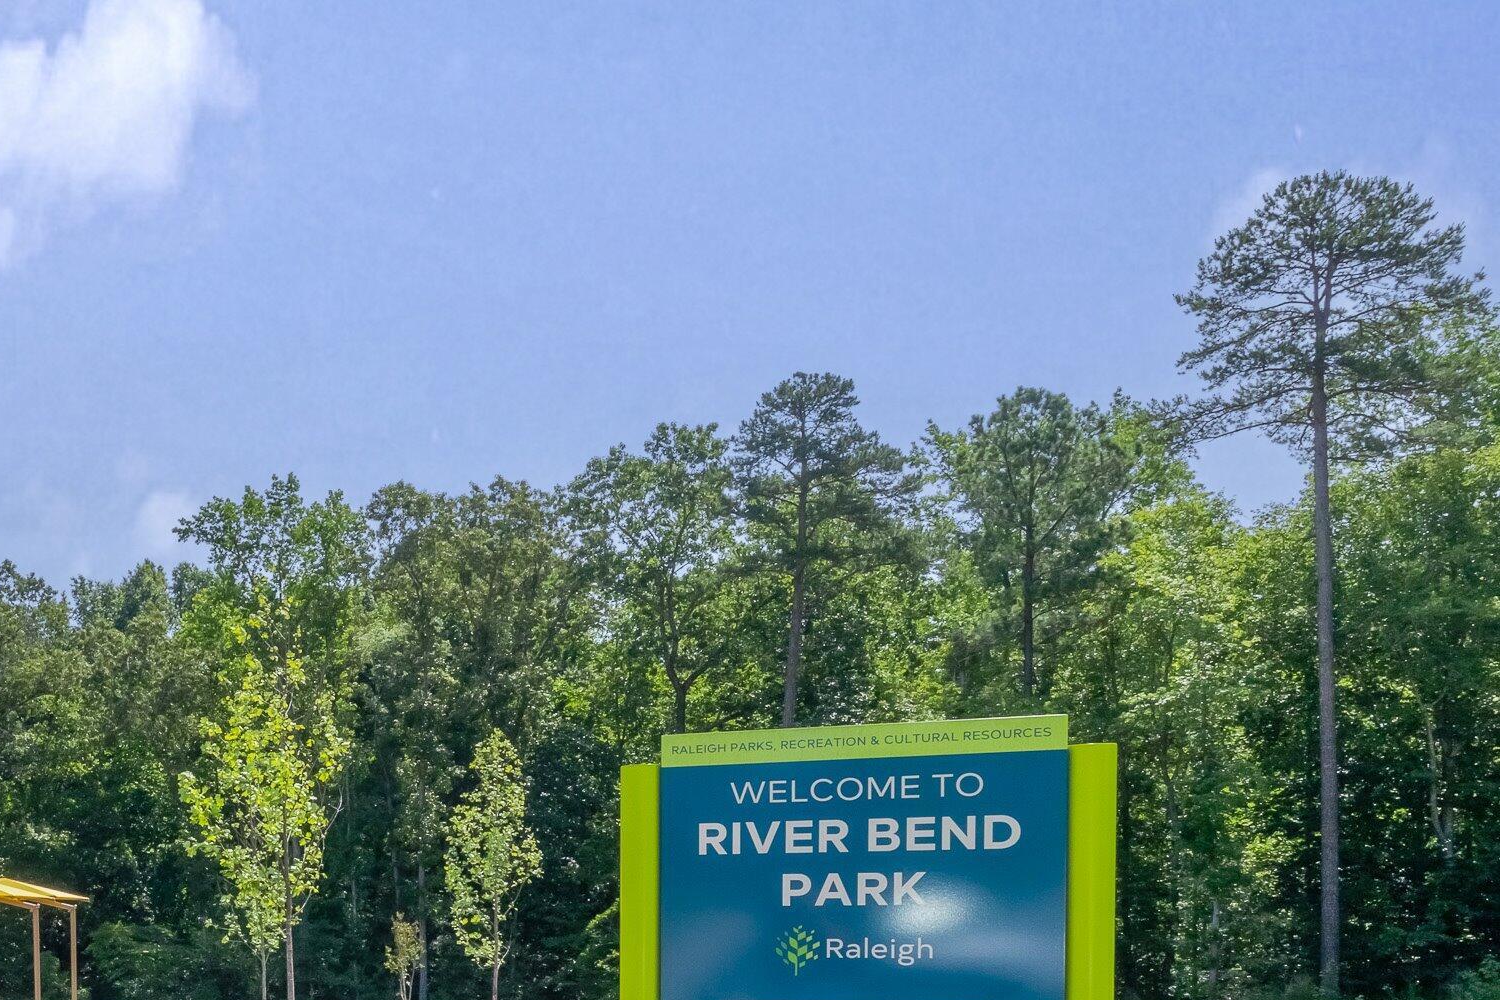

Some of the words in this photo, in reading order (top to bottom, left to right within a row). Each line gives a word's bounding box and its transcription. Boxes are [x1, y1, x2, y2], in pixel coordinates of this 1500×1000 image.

[672, 743, 725, 756] RALEIGH
[730, 740, 776, 753] PARKS,
[780, 736, 866, 750] RECREATION
[871, 736, 880, 746] &
[884, 732, 958, 745] CULTURAL
[963, 727, 1052, 741] RESOURCES
[730, 775, 920, 804] WELCOME
[932, 773, 984, 798] TO
[698, 818, 850, 856] RIVER
[868, 814, 1022, 852] BEND
[782, 872, 926, 906] PARK
[826, 937, 934, 966] Raleigh
